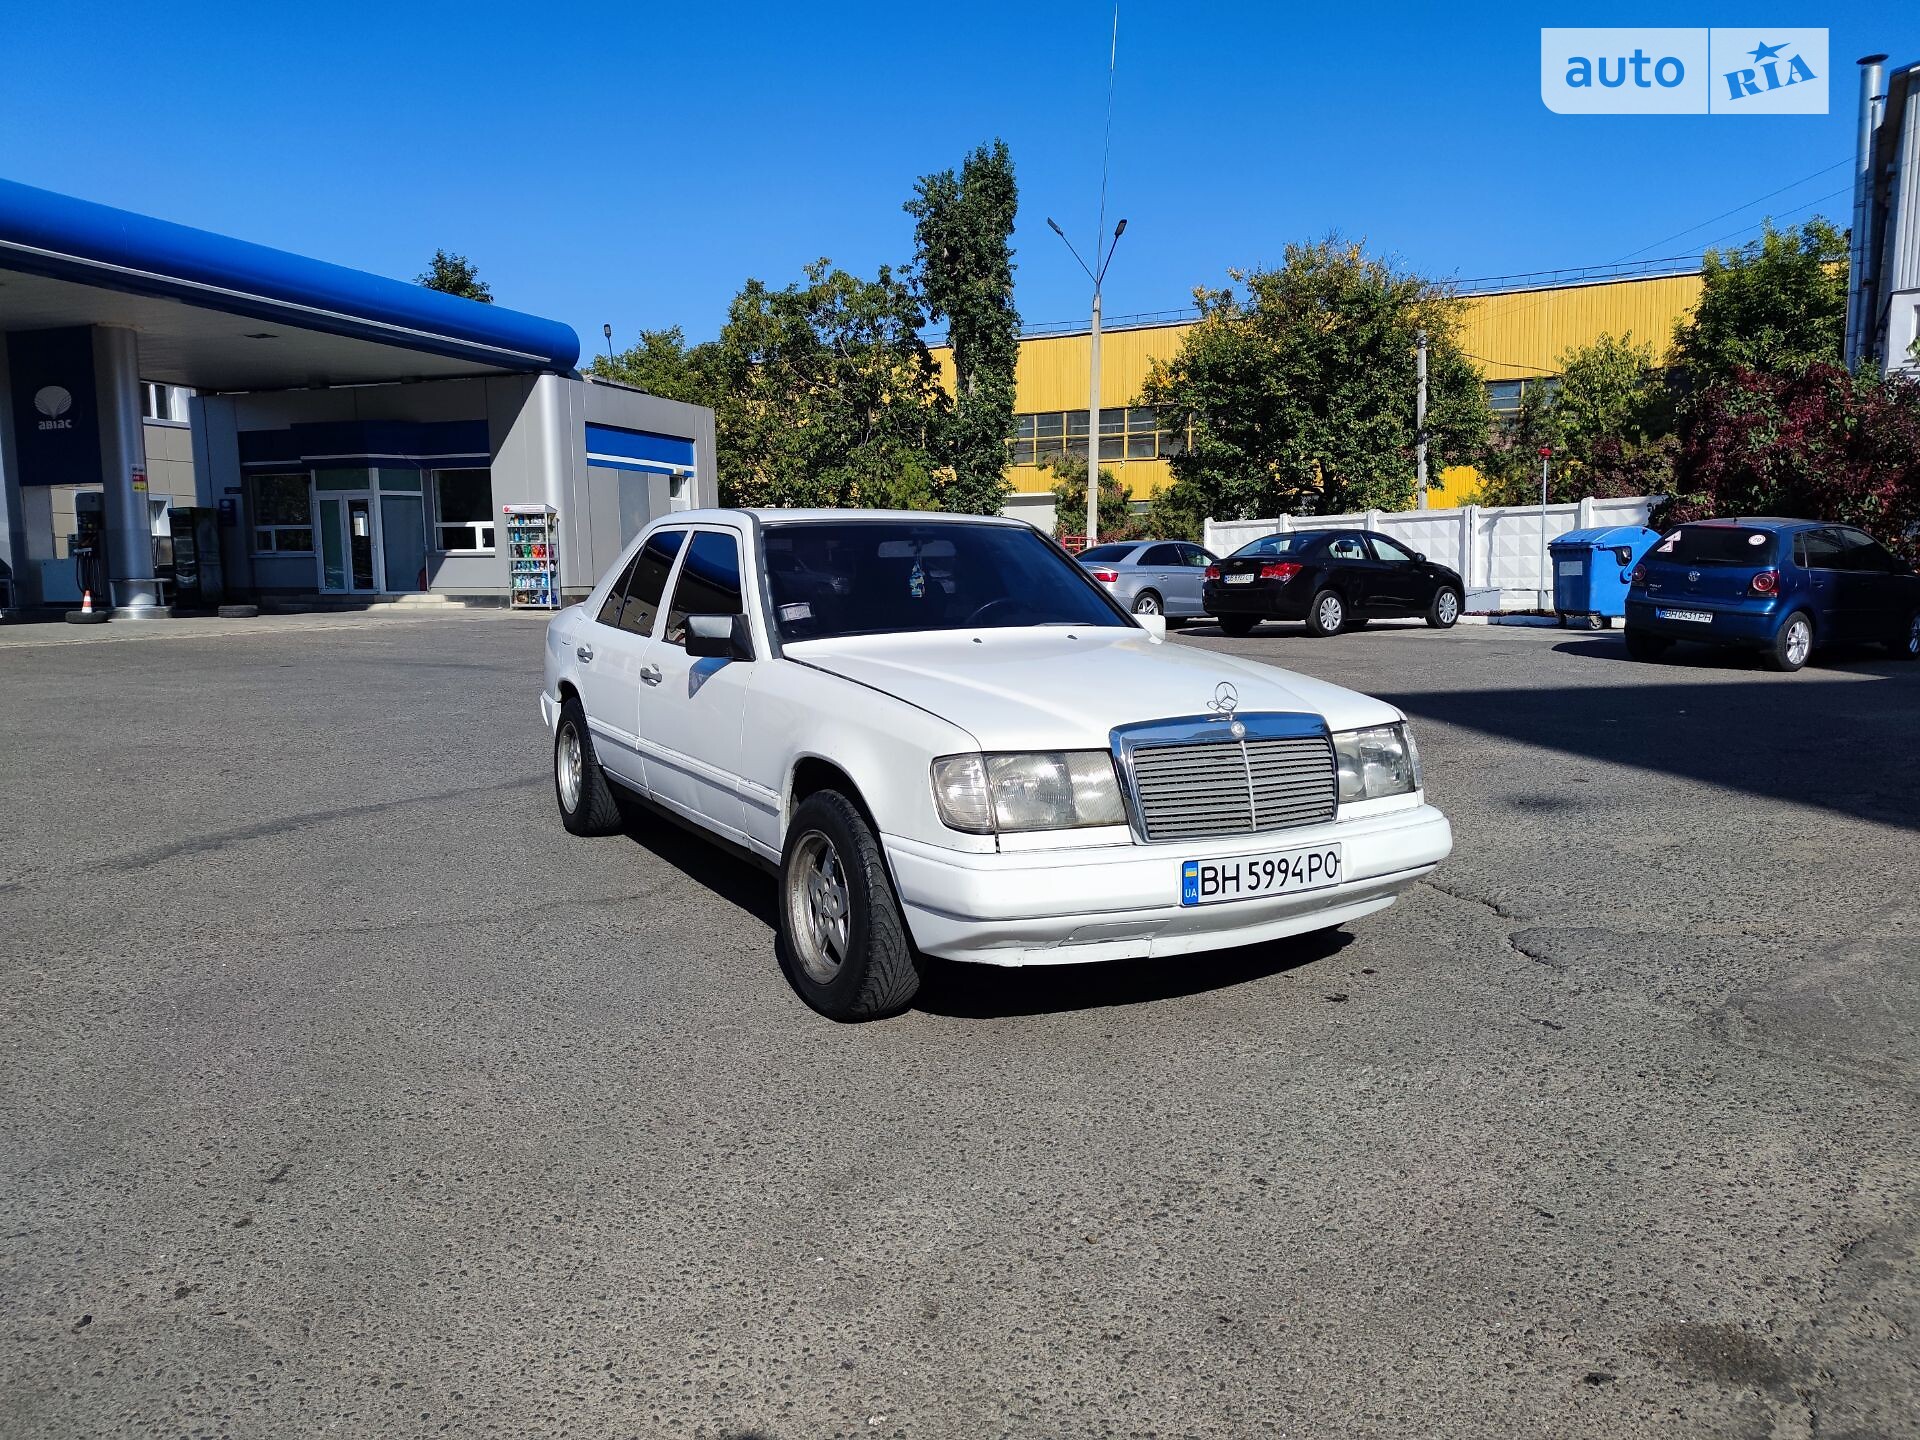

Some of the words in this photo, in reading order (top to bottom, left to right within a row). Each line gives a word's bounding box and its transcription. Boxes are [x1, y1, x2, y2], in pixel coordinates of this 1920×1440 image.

[1201, 863, 1240, 896] BH
[1248, 855, 1304, 891] 5994
[1185, 888, 1198, 898] UA
